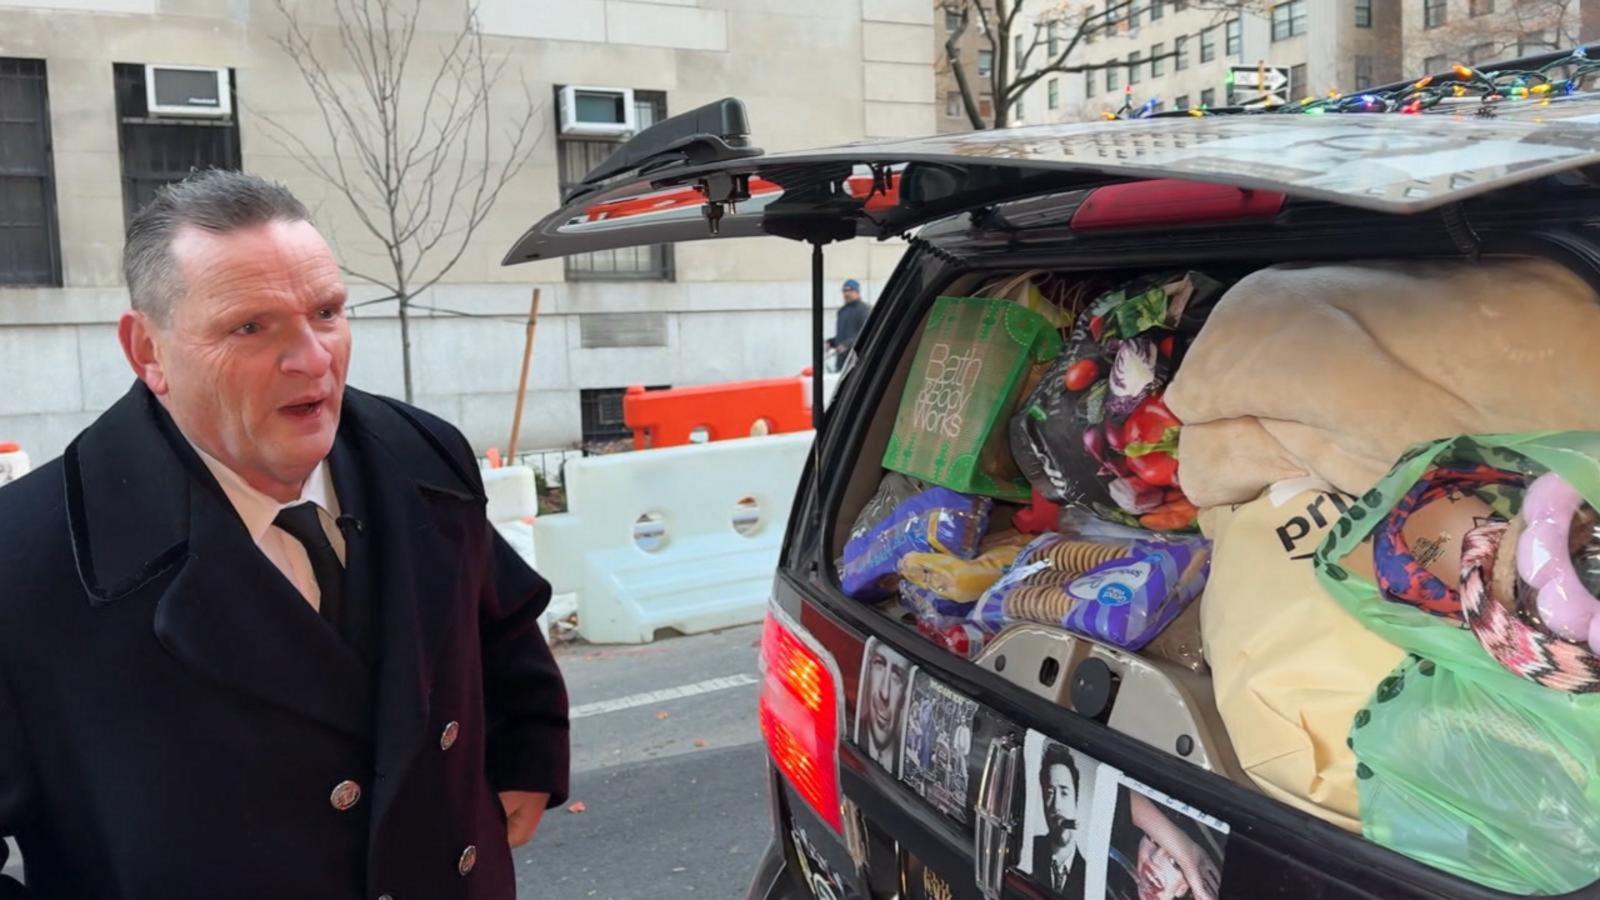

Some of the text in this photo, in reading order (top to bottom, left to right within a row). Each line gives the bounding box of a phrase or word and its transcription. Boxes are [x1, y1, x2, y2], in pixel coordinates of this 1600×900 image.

[925, 343, 982, 388] Bath
[914, 400, 962, 437] Works
[1275, 492, 1349, 552] pri
